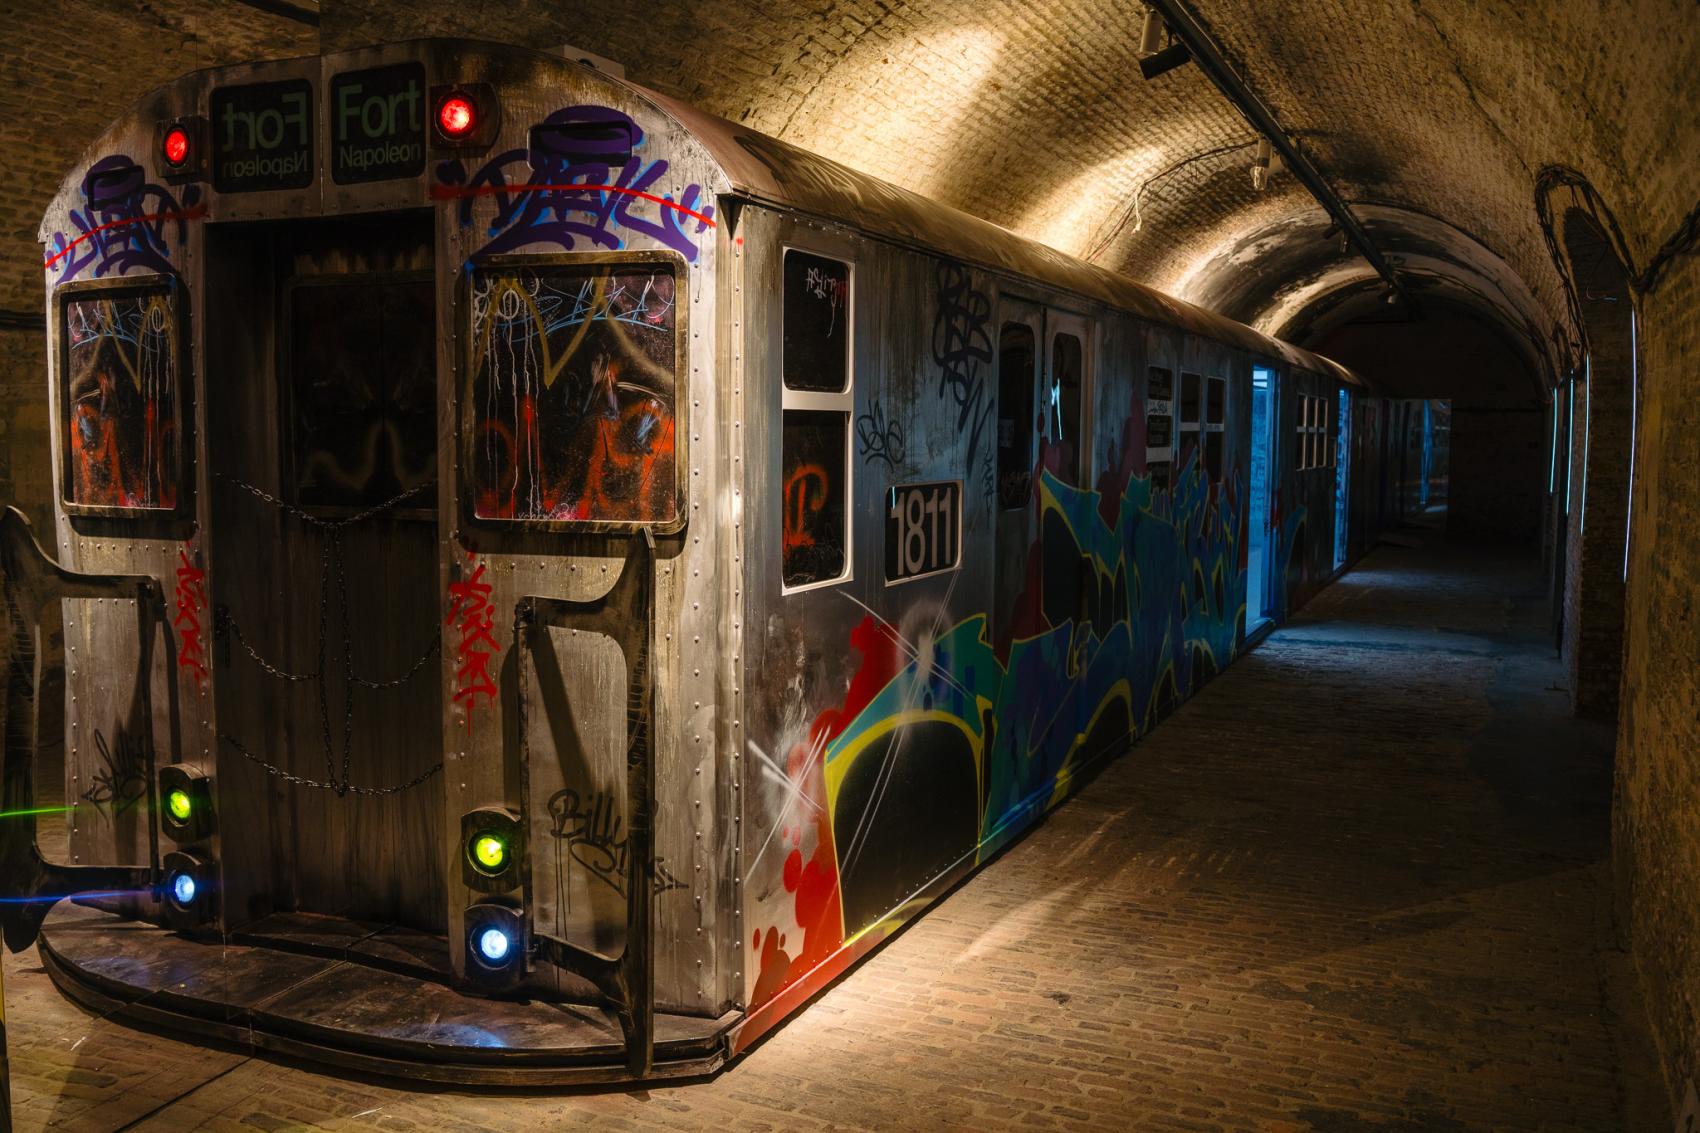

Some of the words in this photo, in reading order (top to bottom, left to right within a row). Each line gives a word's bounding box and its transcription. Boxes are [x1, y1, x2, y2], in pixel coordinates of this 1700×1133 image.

[338, 79, 421, 141] Fort
[339, 140, 421, 171] Napoleon
[890, 487, 953, 576] 1811
